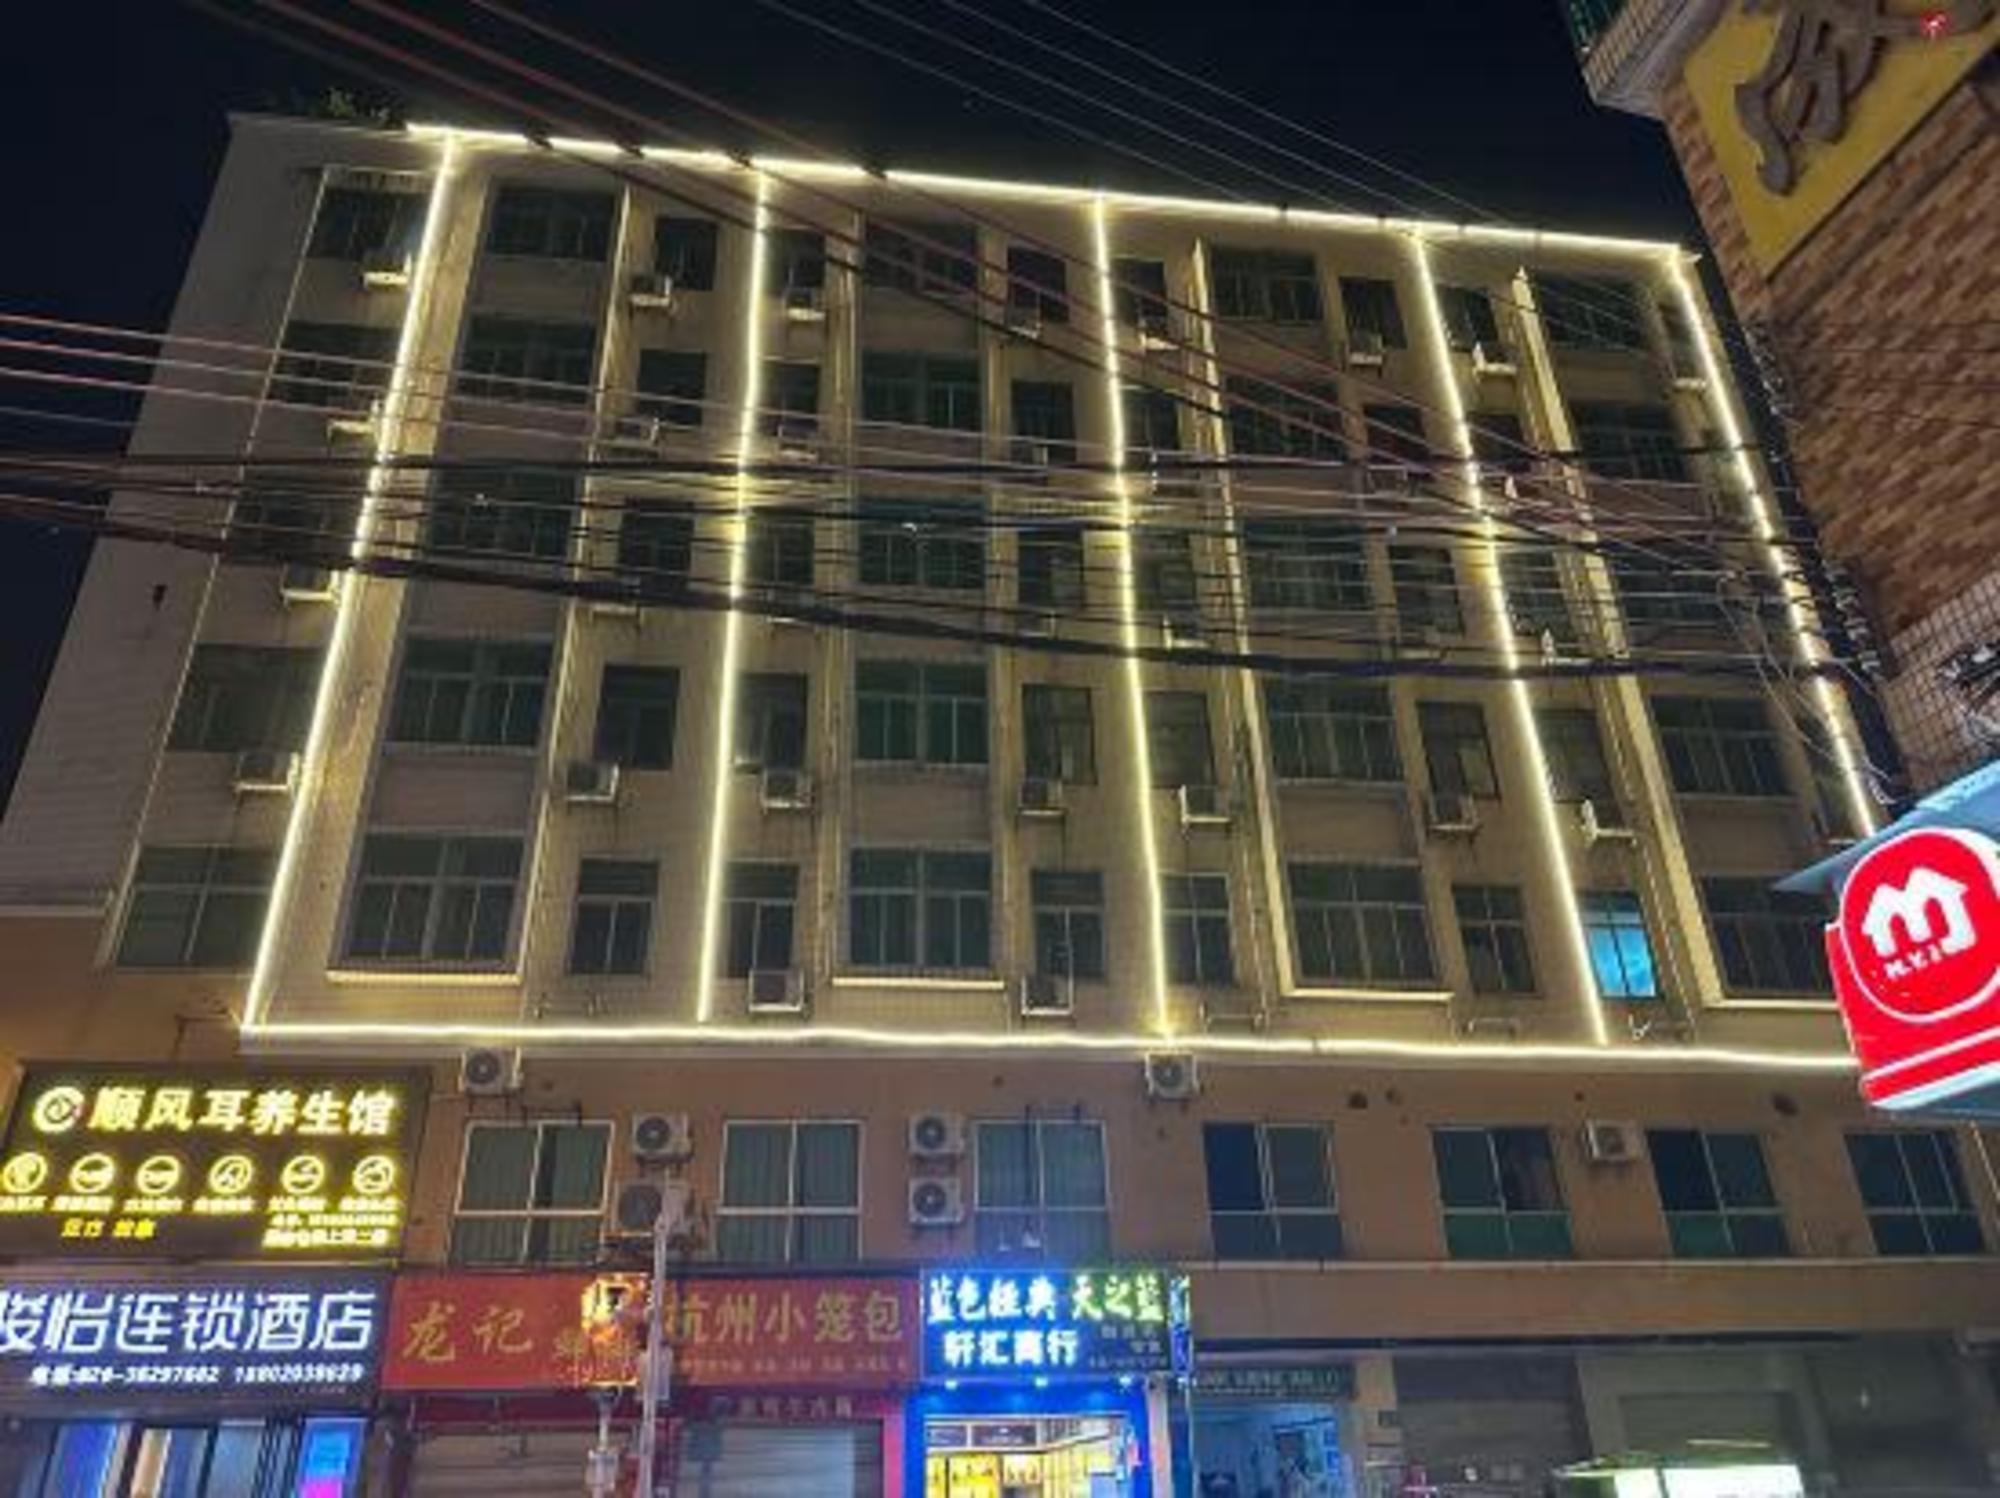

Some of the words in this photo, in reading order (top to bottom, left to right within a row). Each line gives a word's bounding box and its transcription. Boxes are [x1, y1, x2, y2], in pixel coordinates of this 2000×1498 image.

[89, 1085, 396, 1135] 顺风耳养生馆
